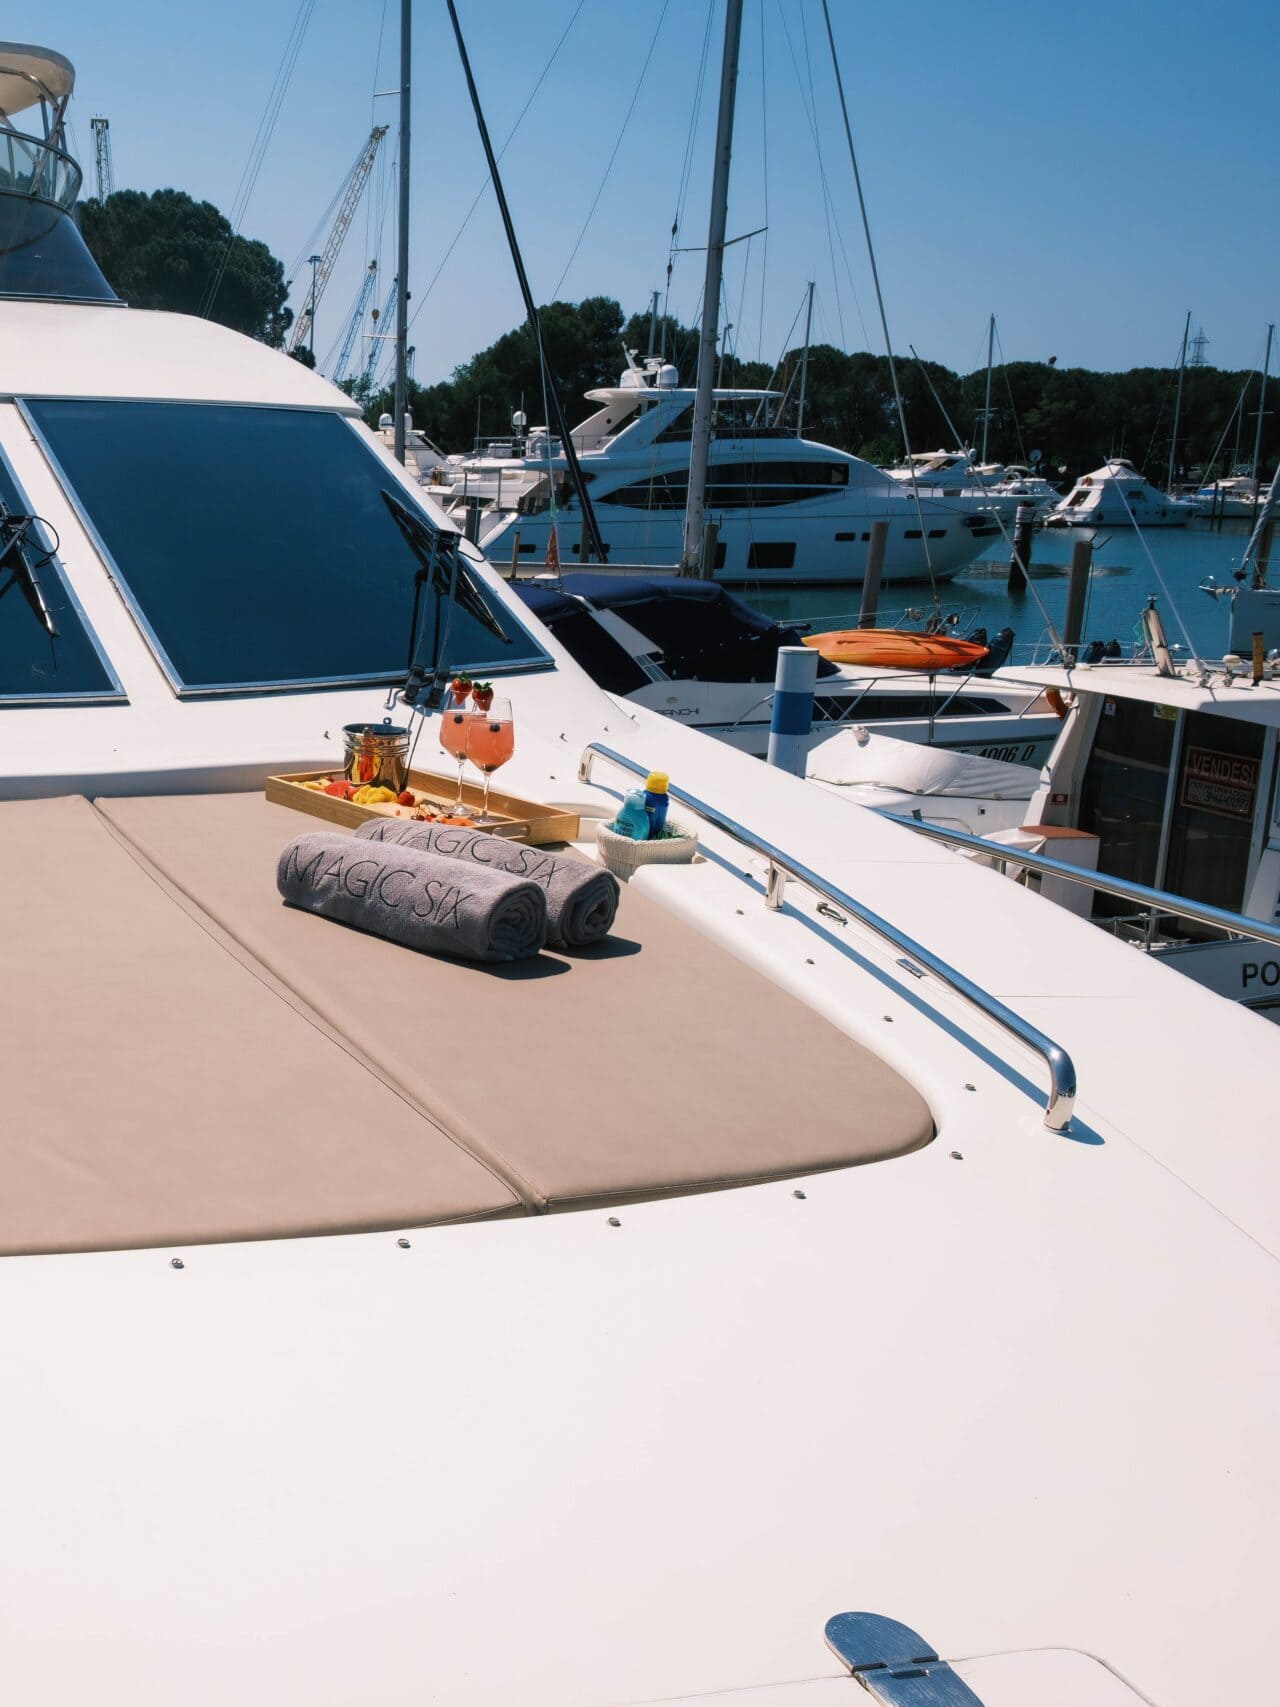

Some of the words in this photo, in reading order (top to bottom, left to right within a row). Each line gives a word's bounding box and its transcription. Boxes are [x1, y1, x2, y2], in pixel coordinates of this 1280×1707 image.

[1192, 752, 1256, 786] VENDESI
[284, 844, 417, 908] MAGIC
[413, 880, 475, 930] SIX
[504, 849, 569, 889] SIX
